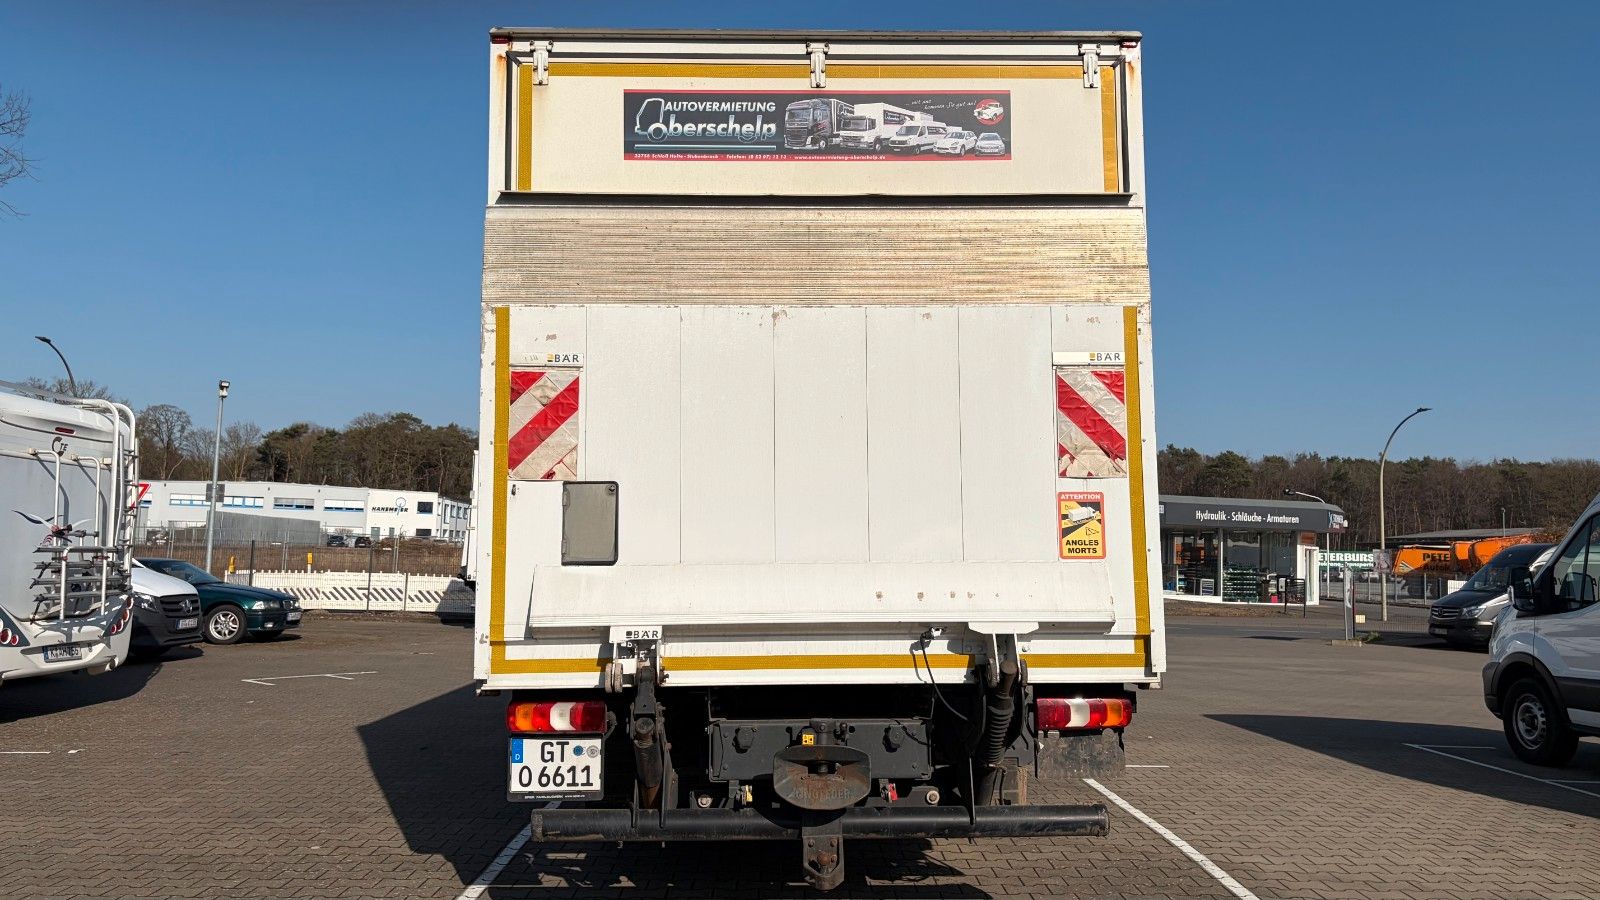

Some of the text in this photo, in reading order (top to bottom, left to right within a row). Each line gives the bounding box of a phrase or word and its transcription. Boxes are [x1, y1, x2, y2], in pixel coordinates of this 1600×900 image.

[664, 101, 776, 112] AUTOVERMIETUNG
[554, 354, 579, 363] BÄR
[1096, 352, 1121, 362] BÄR
[1195, 510, 1227, 521] Hydraulik
[1231, 511, 1262, 522] Schläuche
[1266, 513, 1300, 523] Armaturen
[1065, 539, 1100, 547] ANGLES
[1317, 552, 1374, 562] ETERBURS
[1422, 552, 1450, 561] PETE
[633, 630, 659, 639] BÄR
[540, 741, 570, 763] GT
[538, 765, 594, 788] 6611
